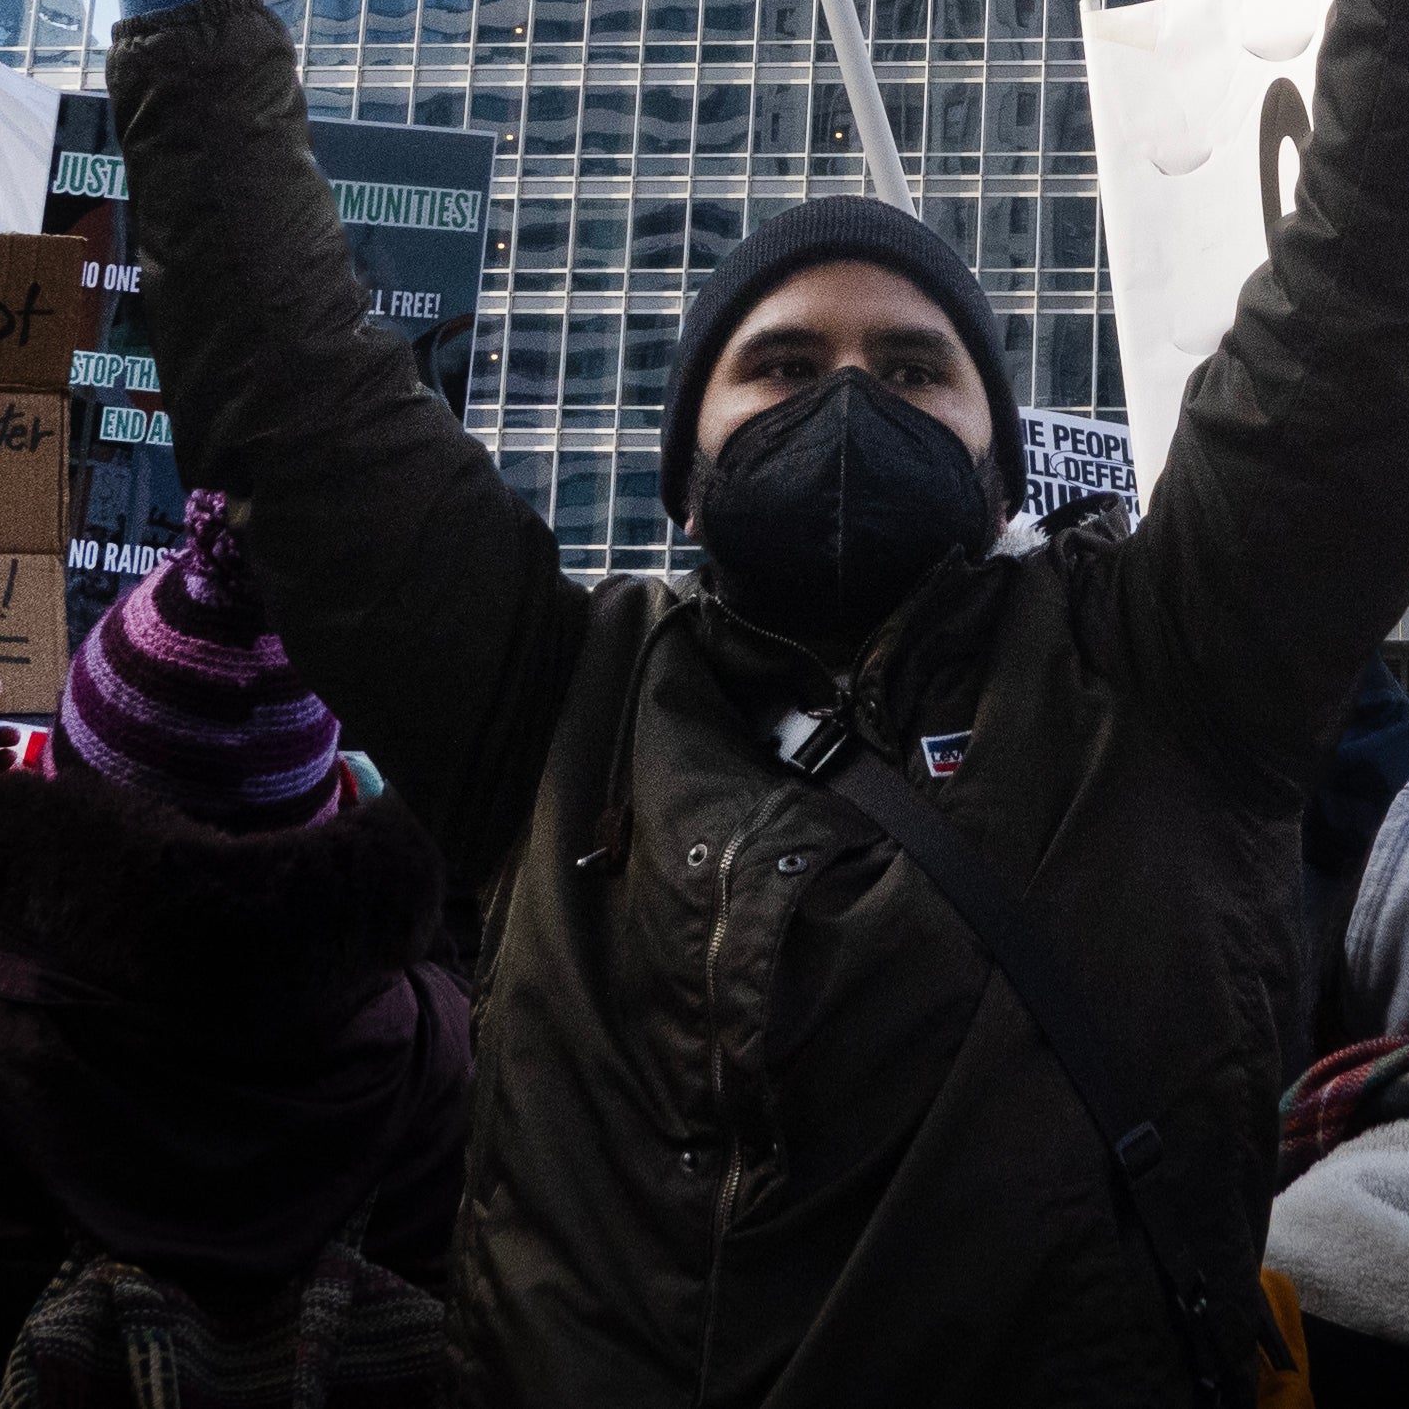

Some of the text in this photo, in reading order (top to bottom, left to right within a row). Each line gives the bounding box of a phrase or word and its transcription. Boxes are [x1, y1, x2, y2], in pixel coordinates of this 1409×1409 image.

[103, 263, 143, 293] ONE
[389, 290, 442, 319] FREE!
[69, 350, 161, 392] STOP TH
[99, 406, 147, 443] END
[1052, 423, 1134, 468] PEOPL
[1064, 456, 1139, 493] DEFEA
[68, 538, 99, 570] NO
